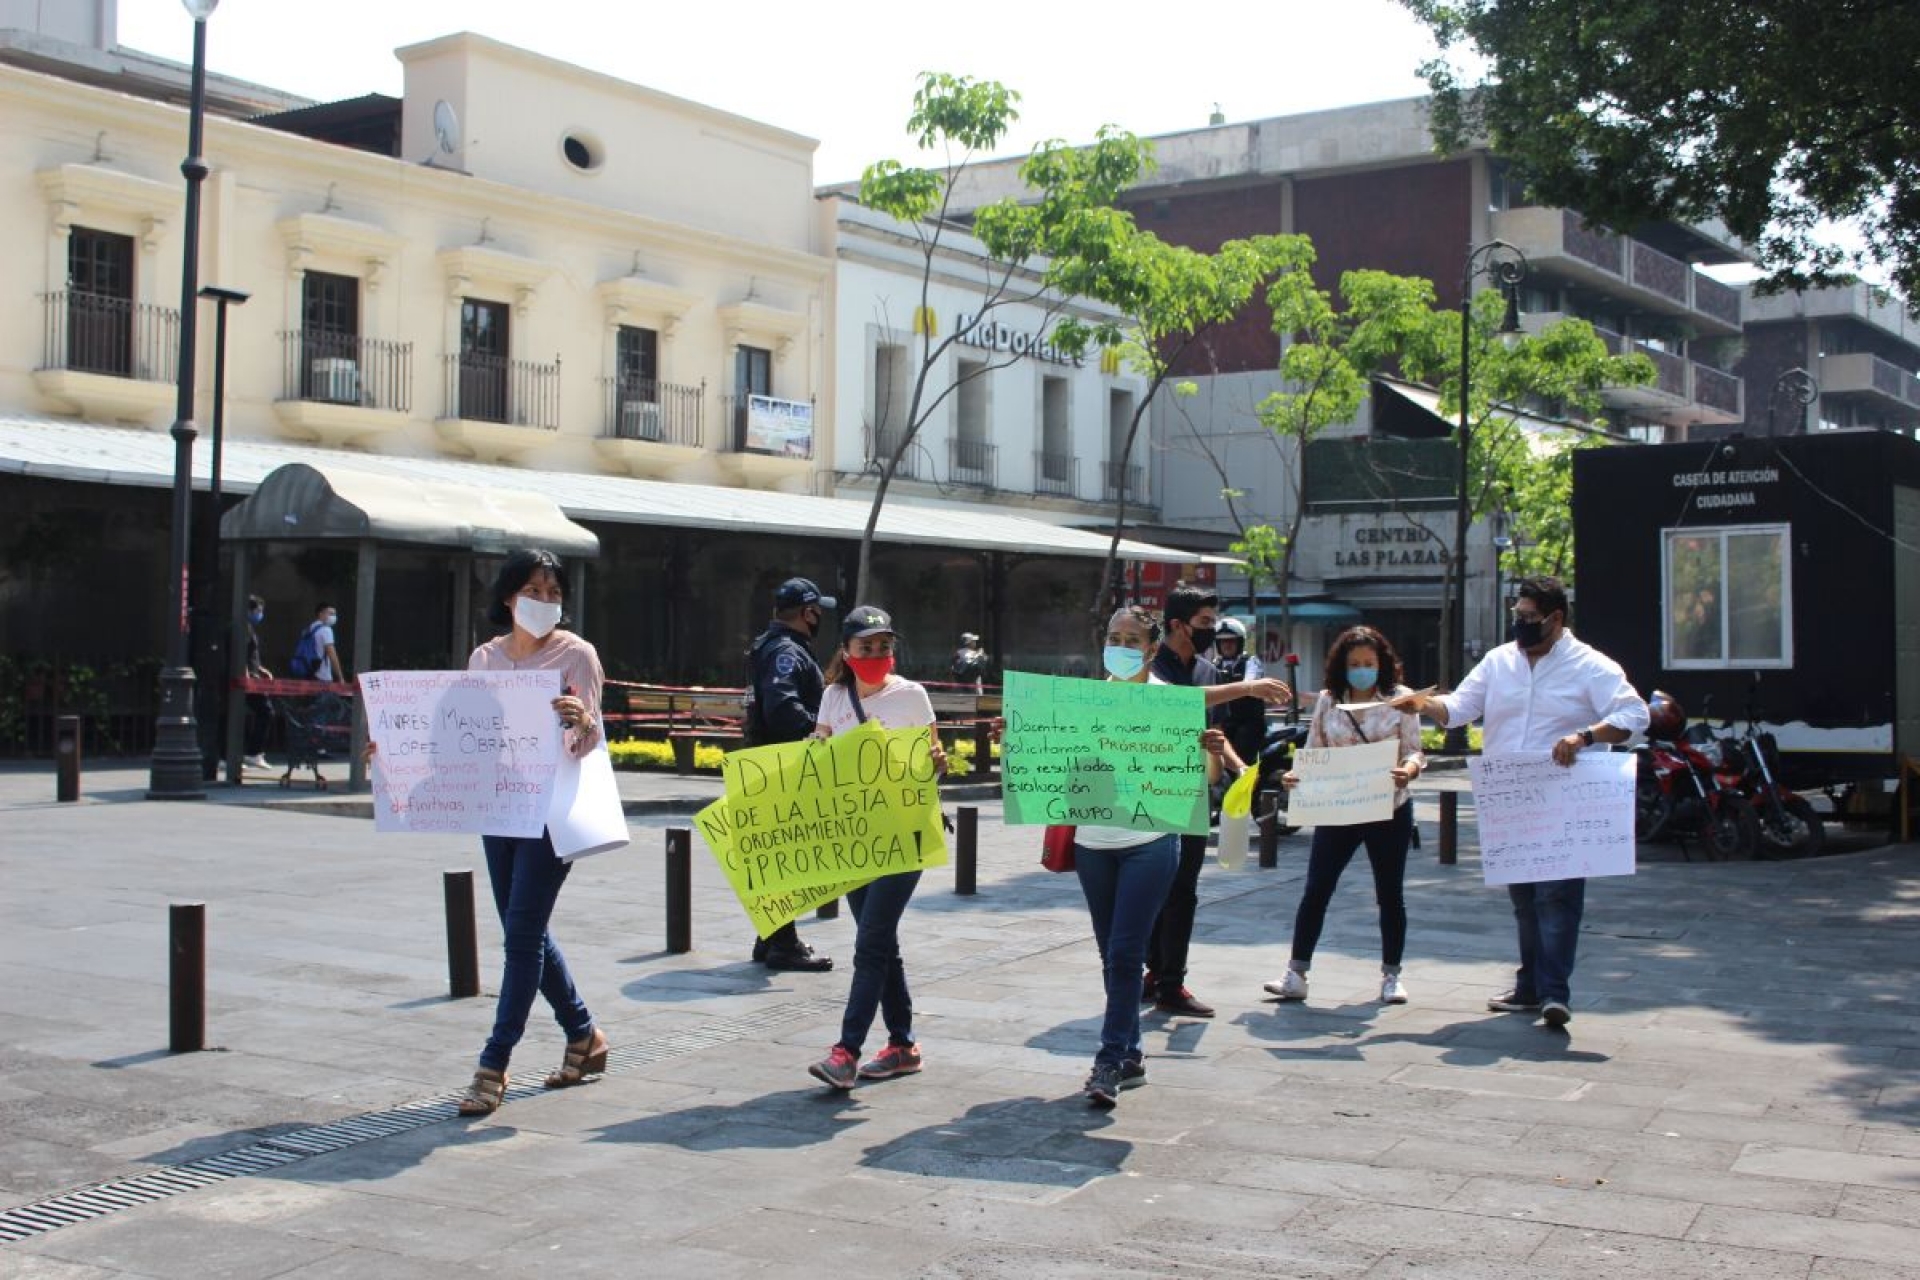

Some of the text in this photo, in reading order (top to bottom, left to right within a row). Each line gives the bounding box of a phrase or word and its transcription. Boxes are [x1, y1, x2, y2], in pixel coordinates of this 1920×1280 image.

[1673, 466, 1779, 487] CASETA DE ATENCIÓN
[1697, 493, 1755, 508] CIUDADANA
[1355, 527, 1431, 544] CENTRO
[1335, 549, 1448, 566] LAS PLAZAS
[440, 705, 511, 732] MANUEL
[1012, 709, 1080, 734] Docentes
[1090, 716, 1107, 734] de
[1115, 724, 1152, 734] nuevo
[460, 732, 539, 754] OBRADOR
[1006, 755, 1206, 775] los resultados de nuestra
[735, 788, 929, 830] DE LA LISTA DE
[1131, 801, 1155, 828] A
[740, 817, 869, 854] ORDENAMIENTO
